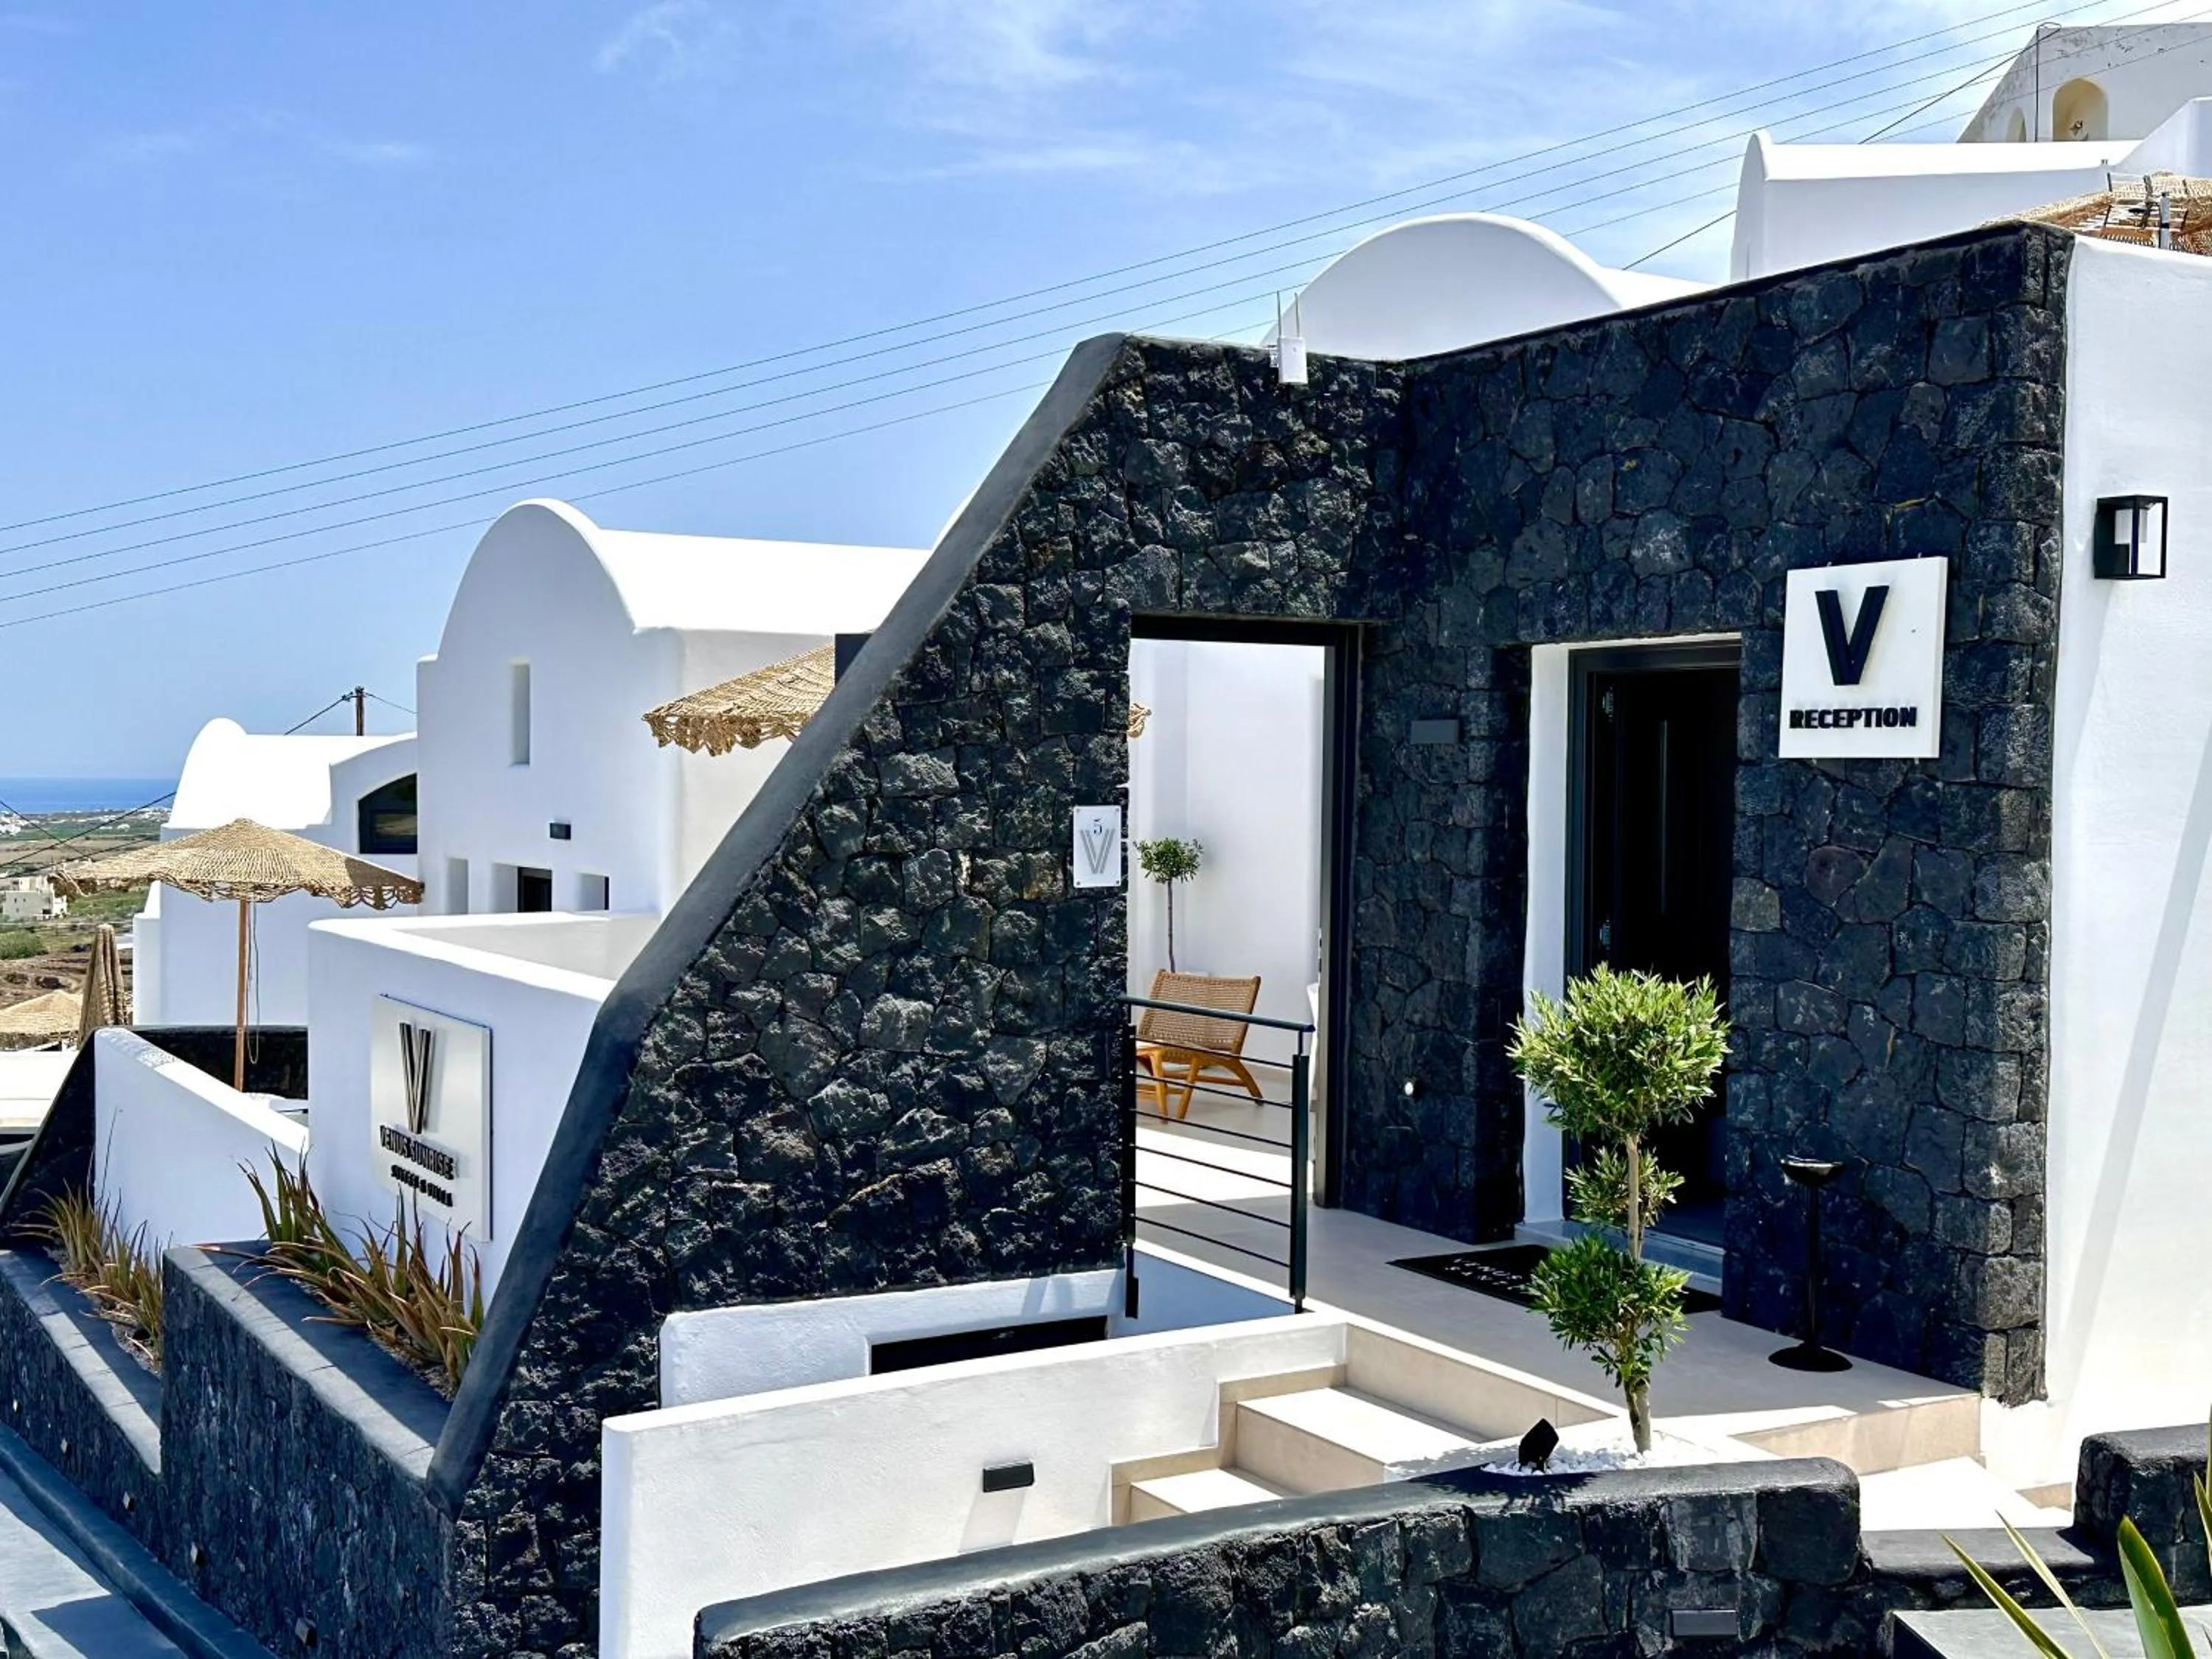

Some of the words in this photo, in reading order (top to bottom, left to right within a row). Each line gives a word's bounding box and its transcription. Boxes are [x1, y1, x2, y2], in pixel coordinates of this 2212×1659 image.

[1815, 585, 1890, 686] V
[1789, 706, 1918, 729] RECEPTION
[399, 1022, 431, 1134] V
[380, 1124, 411, 1158] VENUS
[411, 1140, 454, 1180] SUNRISE
